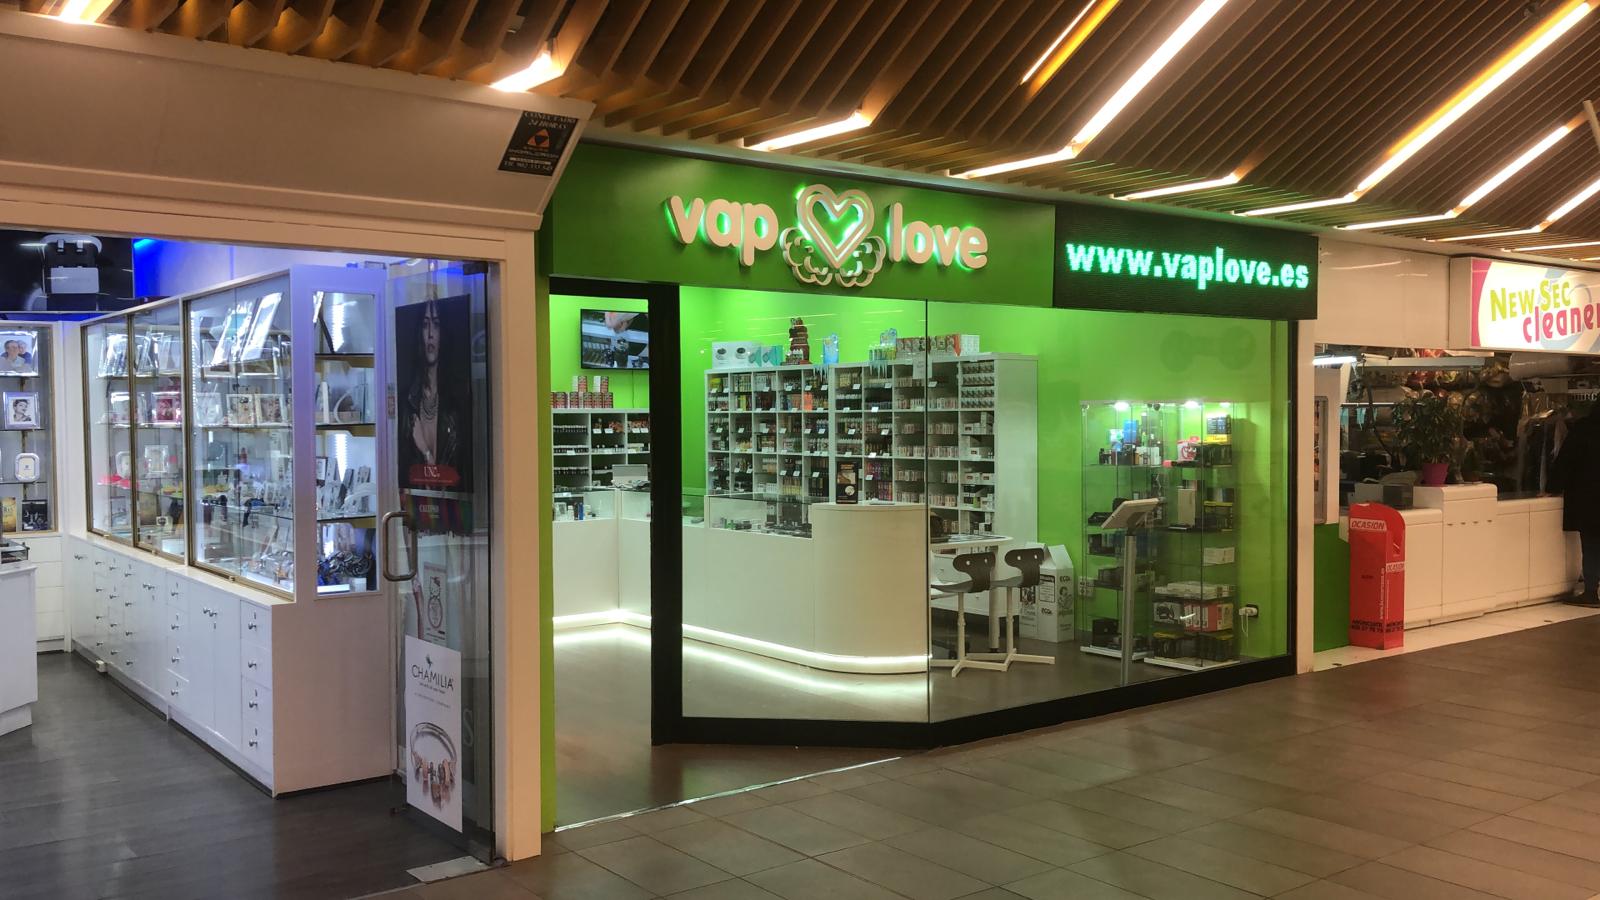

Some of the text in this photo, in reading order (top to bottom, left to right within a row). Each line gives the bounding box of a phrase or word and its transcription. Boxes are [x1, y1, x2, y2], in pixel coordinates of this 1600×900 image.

[666, 194, 989, 270] vap love
[1065, 242, 1310, 291] www.vaplove.es
[1351, 520, 1385, 530] OCASION
[412, 664, 454, 691] CHAMILIA
